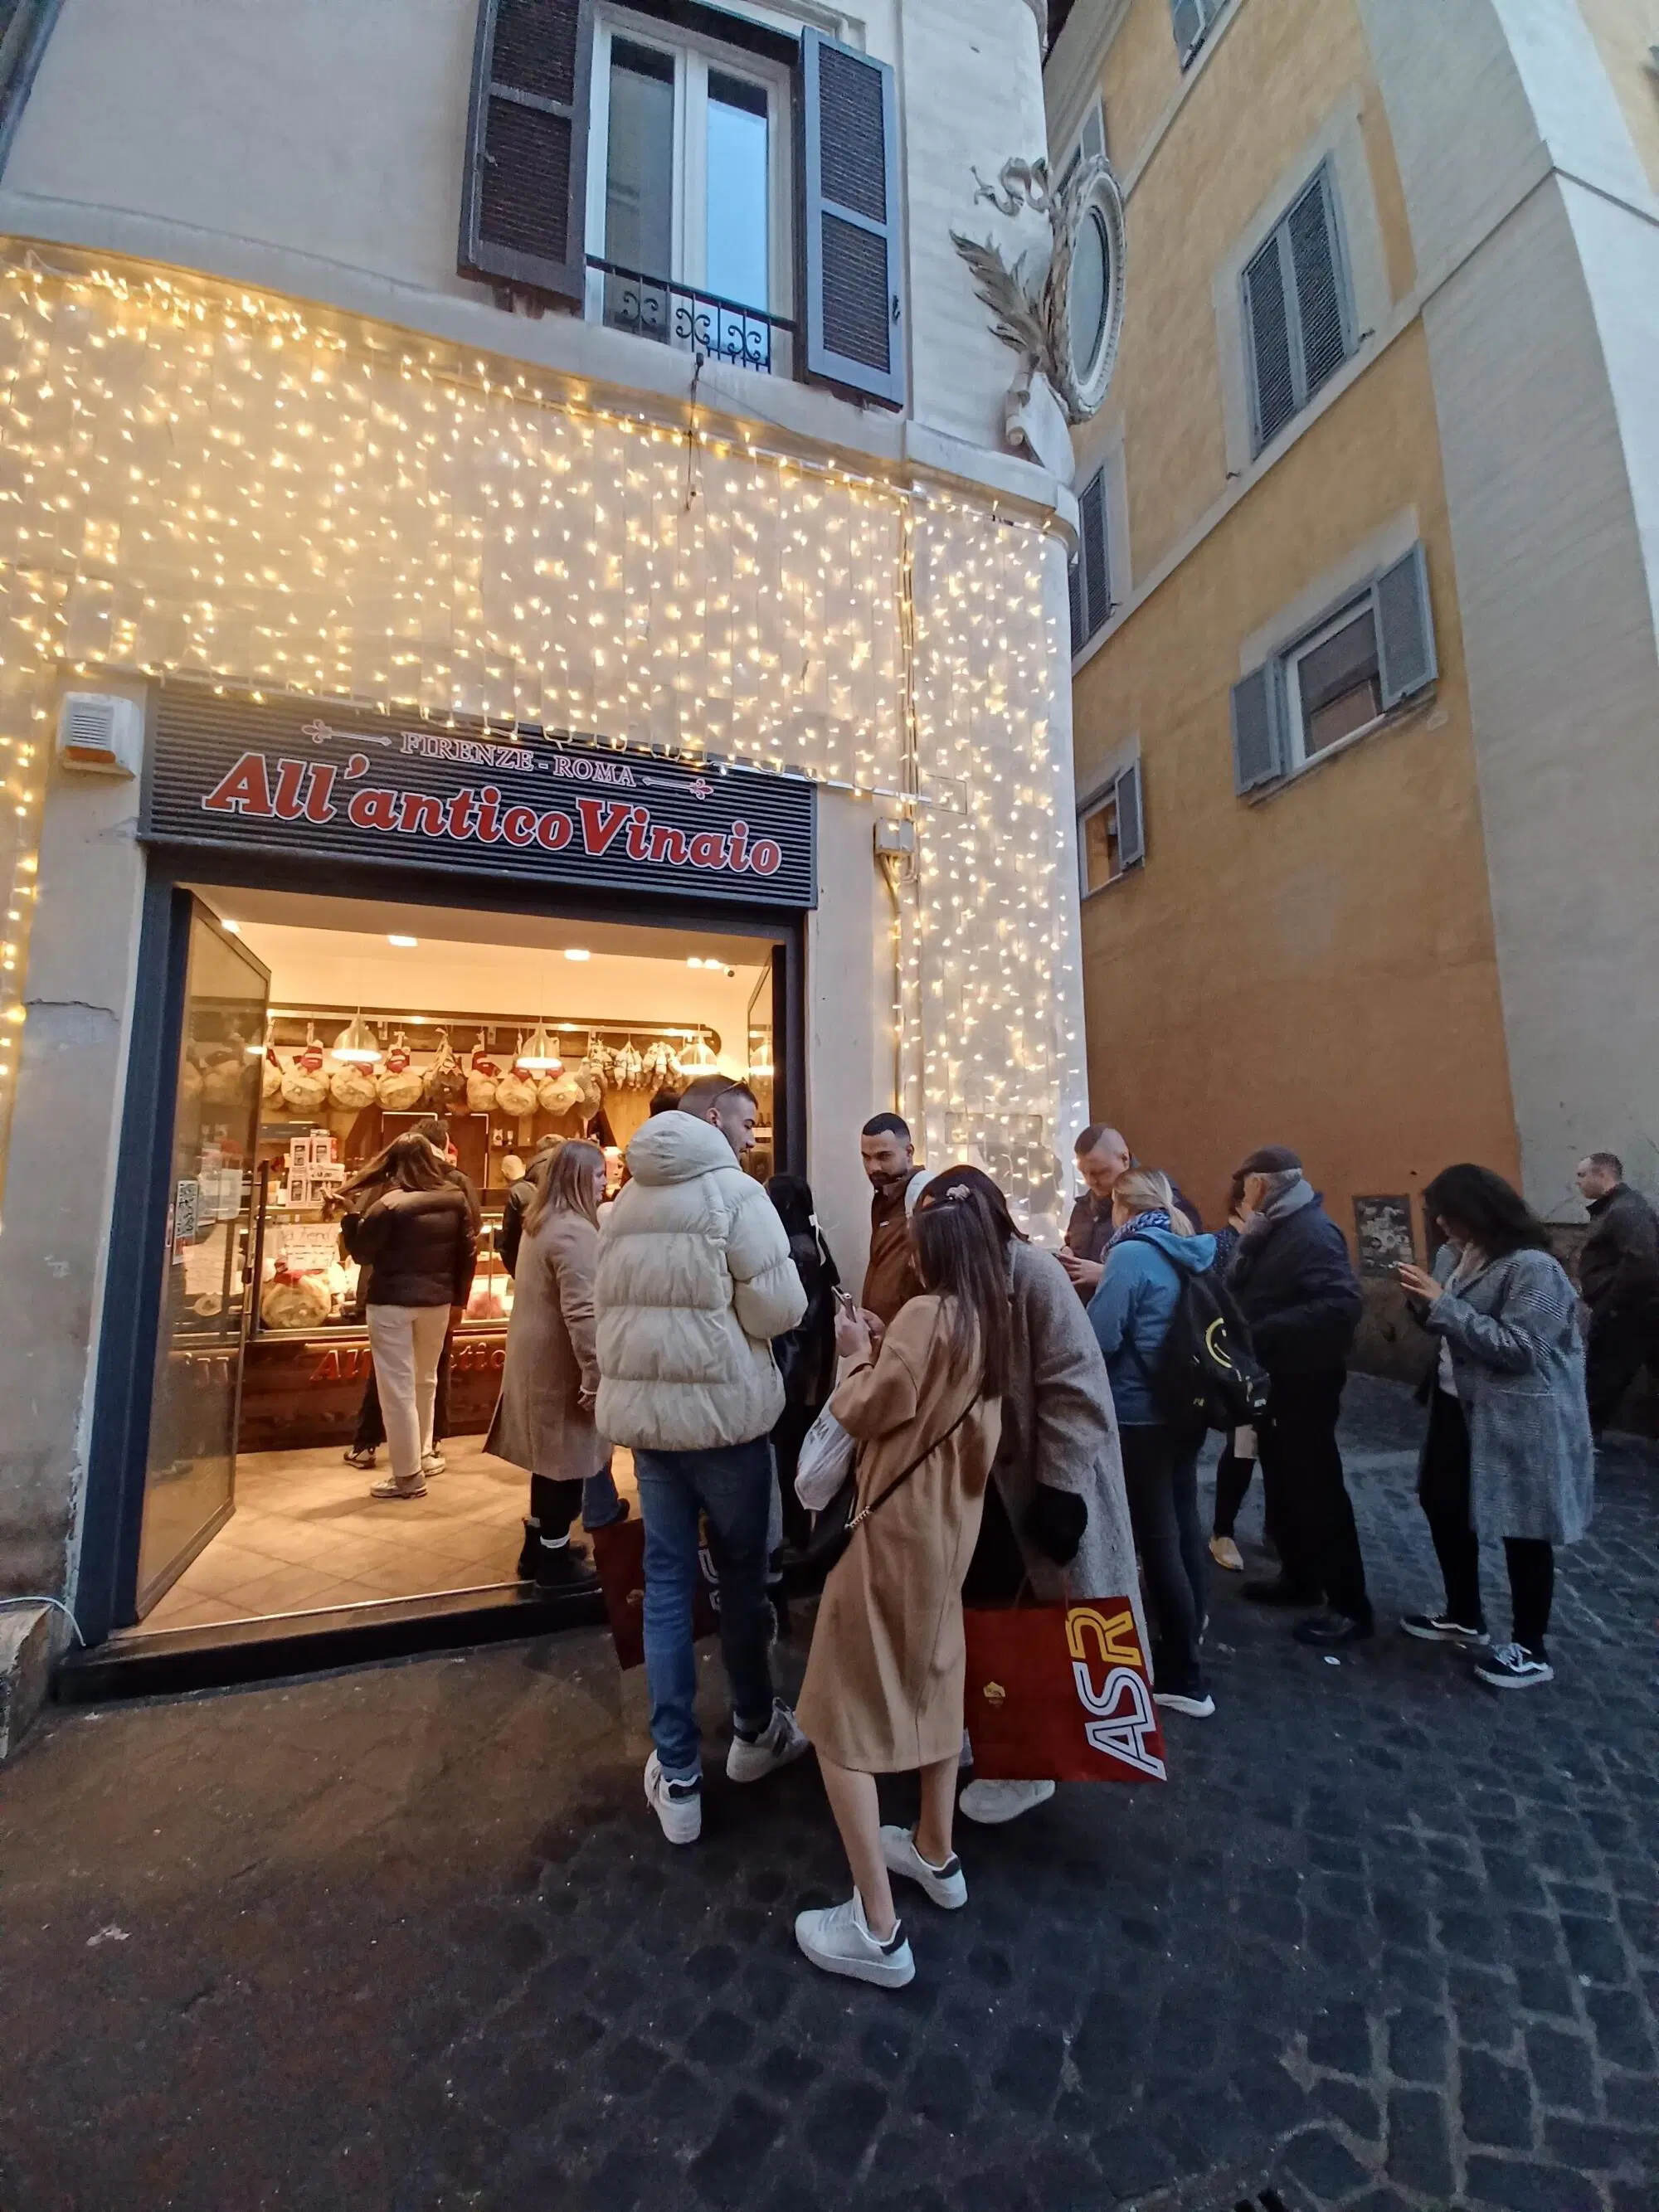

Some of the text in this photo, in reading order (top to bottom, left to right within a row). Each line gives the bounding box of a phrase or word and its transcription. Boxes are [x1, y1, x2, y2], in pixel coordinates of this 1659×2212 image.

[400, 732, 534, 771] FIRENZE
[553, 755, 637, 787] ROMA
[1065, 1607, 1168, 1781] ASR
